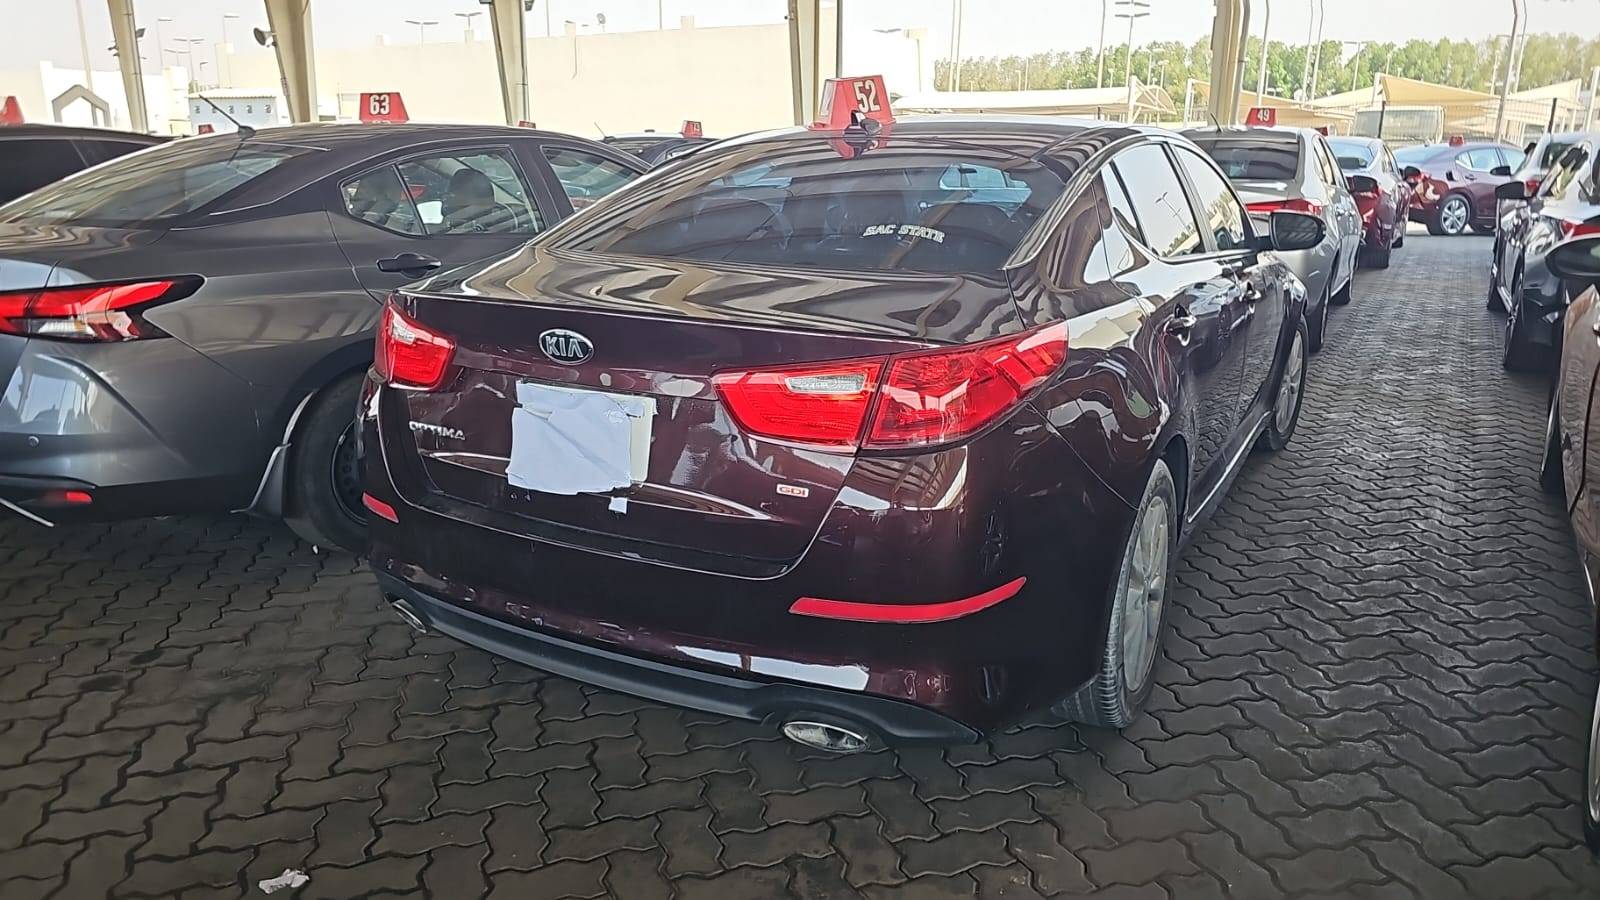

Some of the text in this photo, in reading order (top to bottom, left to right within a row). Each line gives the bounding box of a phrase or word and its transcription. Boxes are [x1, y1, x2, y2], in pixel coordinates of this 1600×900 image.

[370, 94, 390, 115] 63
[853, 80, 880, 113] 52
[1257, 109, 1270, 122] 49
[862, 225, 945, 243] SAC STATE
[545, 336, 583, 357] KIA
[409, 421, 465, 440] OPTIMA
